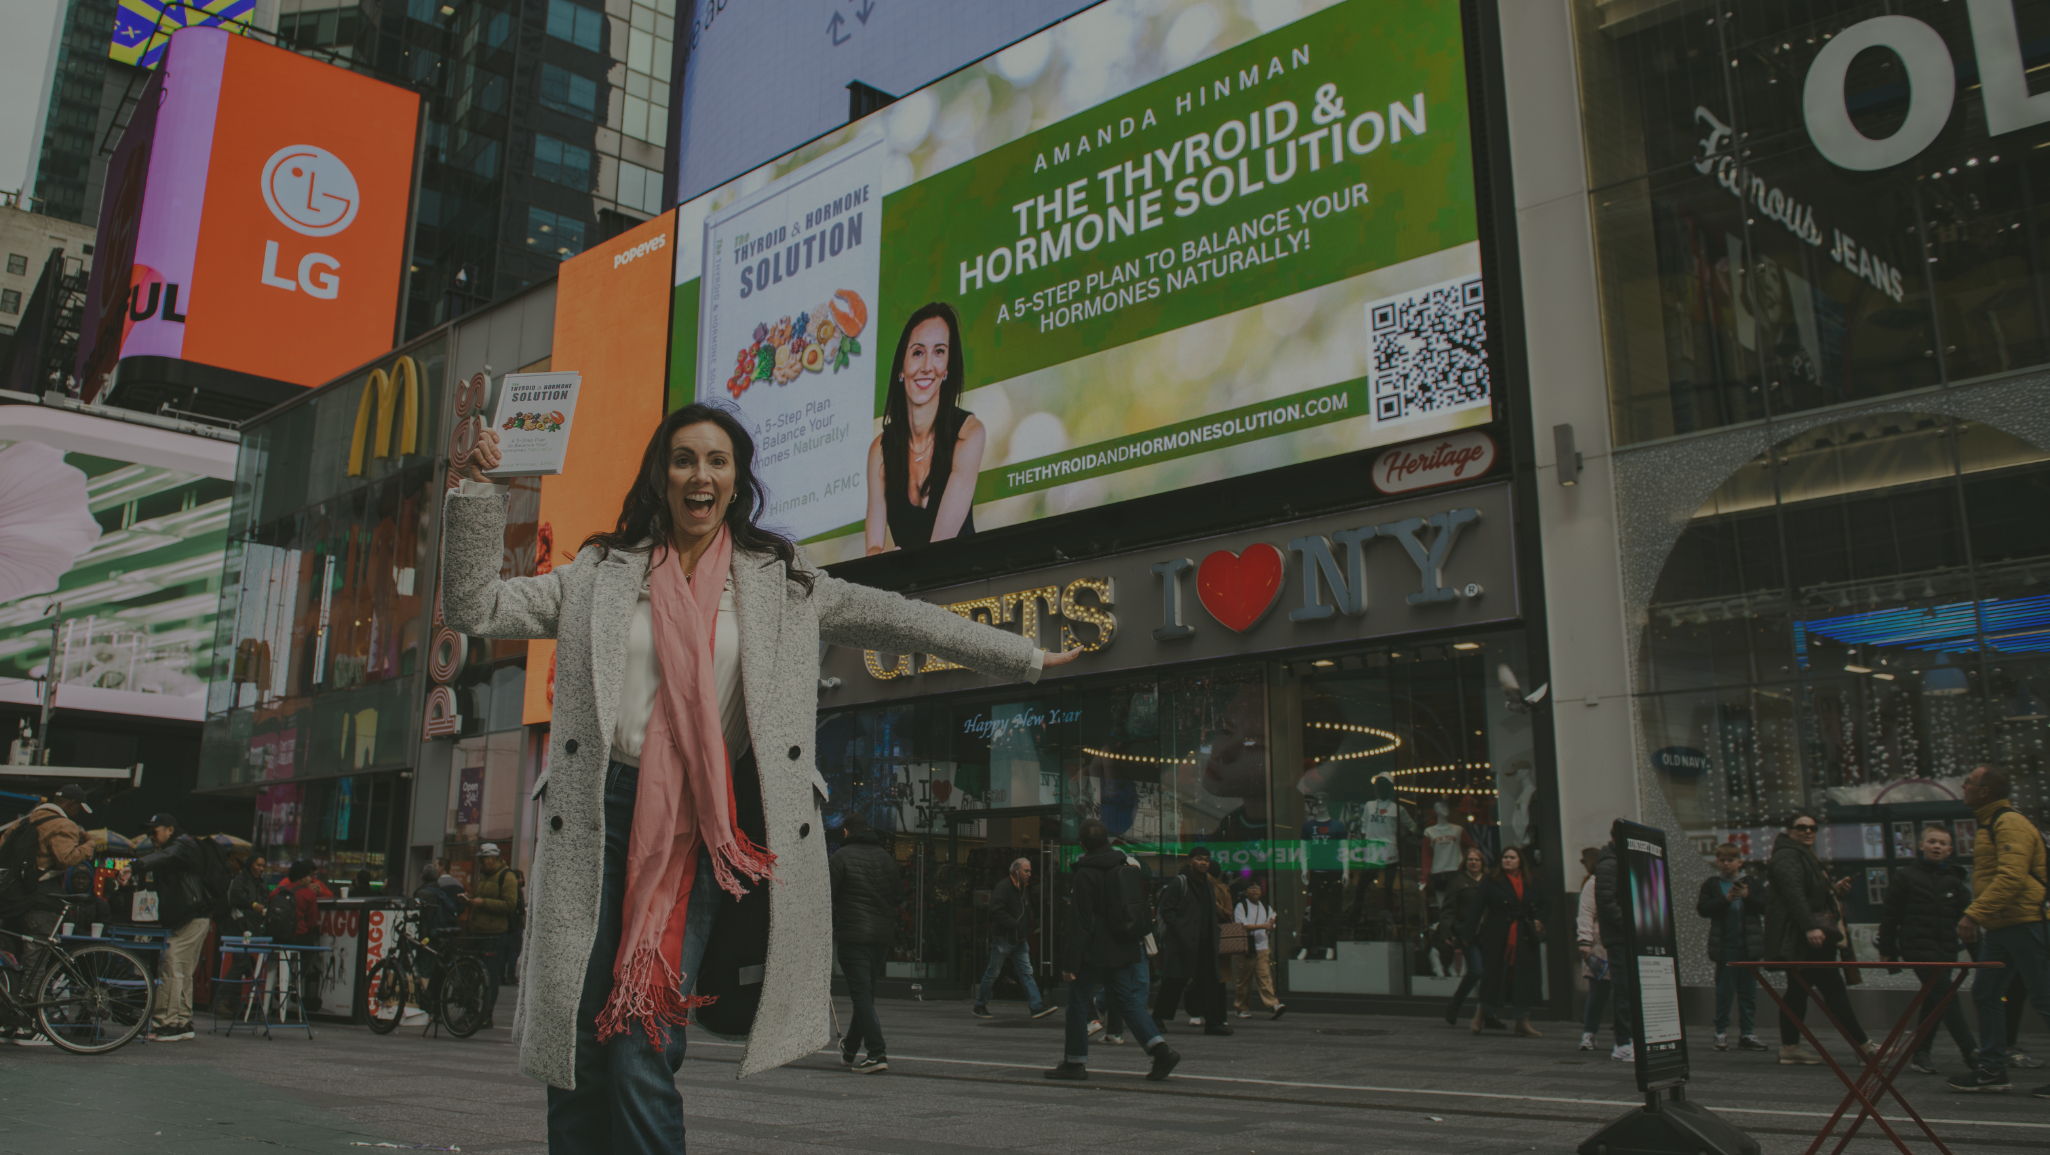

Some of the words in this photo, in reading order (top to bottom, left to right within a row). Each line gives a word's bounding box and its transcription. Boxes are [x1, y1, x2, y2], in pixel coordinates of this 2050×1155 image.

[1034, 108, 1157, 174] AMANDA
[1176, 43, 1310, 117] HINMAN
[1012, 178, 1089, 236] THE
[1097, 100, 1298, 206] THYROID
[1311, 82, 1346, 125] &
[1693, 105, 1822, 246] Famous
[959, 190, 1164, 297] HORMONE
[1173, 92, 1428, 217] SOLUTION
[734, 226, 786, 265] THYROID
[791, 222, 801, 237] &
[805, 184, 870, 230] HORMONE
[735, 232, 749, 248] The
[261, 239, 341, 300] LG
[739, 211, 863, 299] SOLUTION
[996, 304, 1011, 324] A
[1014, 279, 1081, 319] 5-STEP
[1086, 259, 1141, 294] PLAN
[1145, 247, 1176, 274] TO
[1181, 207, 1291, 264] BALANCE
[1295, 183, 1369, 225] YOUR
[1831, 228, 1904, 302] JEANS
[713, 259, 721, 302] THYROID
[1039, 278, 1161, 333] HORMONES
[1166, 228, 1311, 294] NATURALLY!
[511, 390, 569, 402] SOLUTION
[754, 424, 762, 436] A
[765, 412, 802, 433] 5-Step
[805, 398, 831, 417] Plan
[762, 426, 806, 452] Balance
[809, 414, 835, 432] Your
[793, 423, 849, 456] Naturally!
[1007, 392, 1348, 488] THETHYROIDANDHORMONESOLUTION.COM
[1383, 442, 1485, 484] Heritage
[770, 491, 819, 516] Hinman,
[824, 473, 860, 498] AFMC
[1150, 557, 1195, 641] I
[964, 713, 1008, 739] Happy
[1012, 708, 1044, 728] New
[1048, 709, 1082, 725] Year
[462, 782, 479, 792] Open
[1662, 754, 1681, 767] OLD
[1683, 756, 1706, 769] NAVY
[981, 789, 1006, 803] 1520
